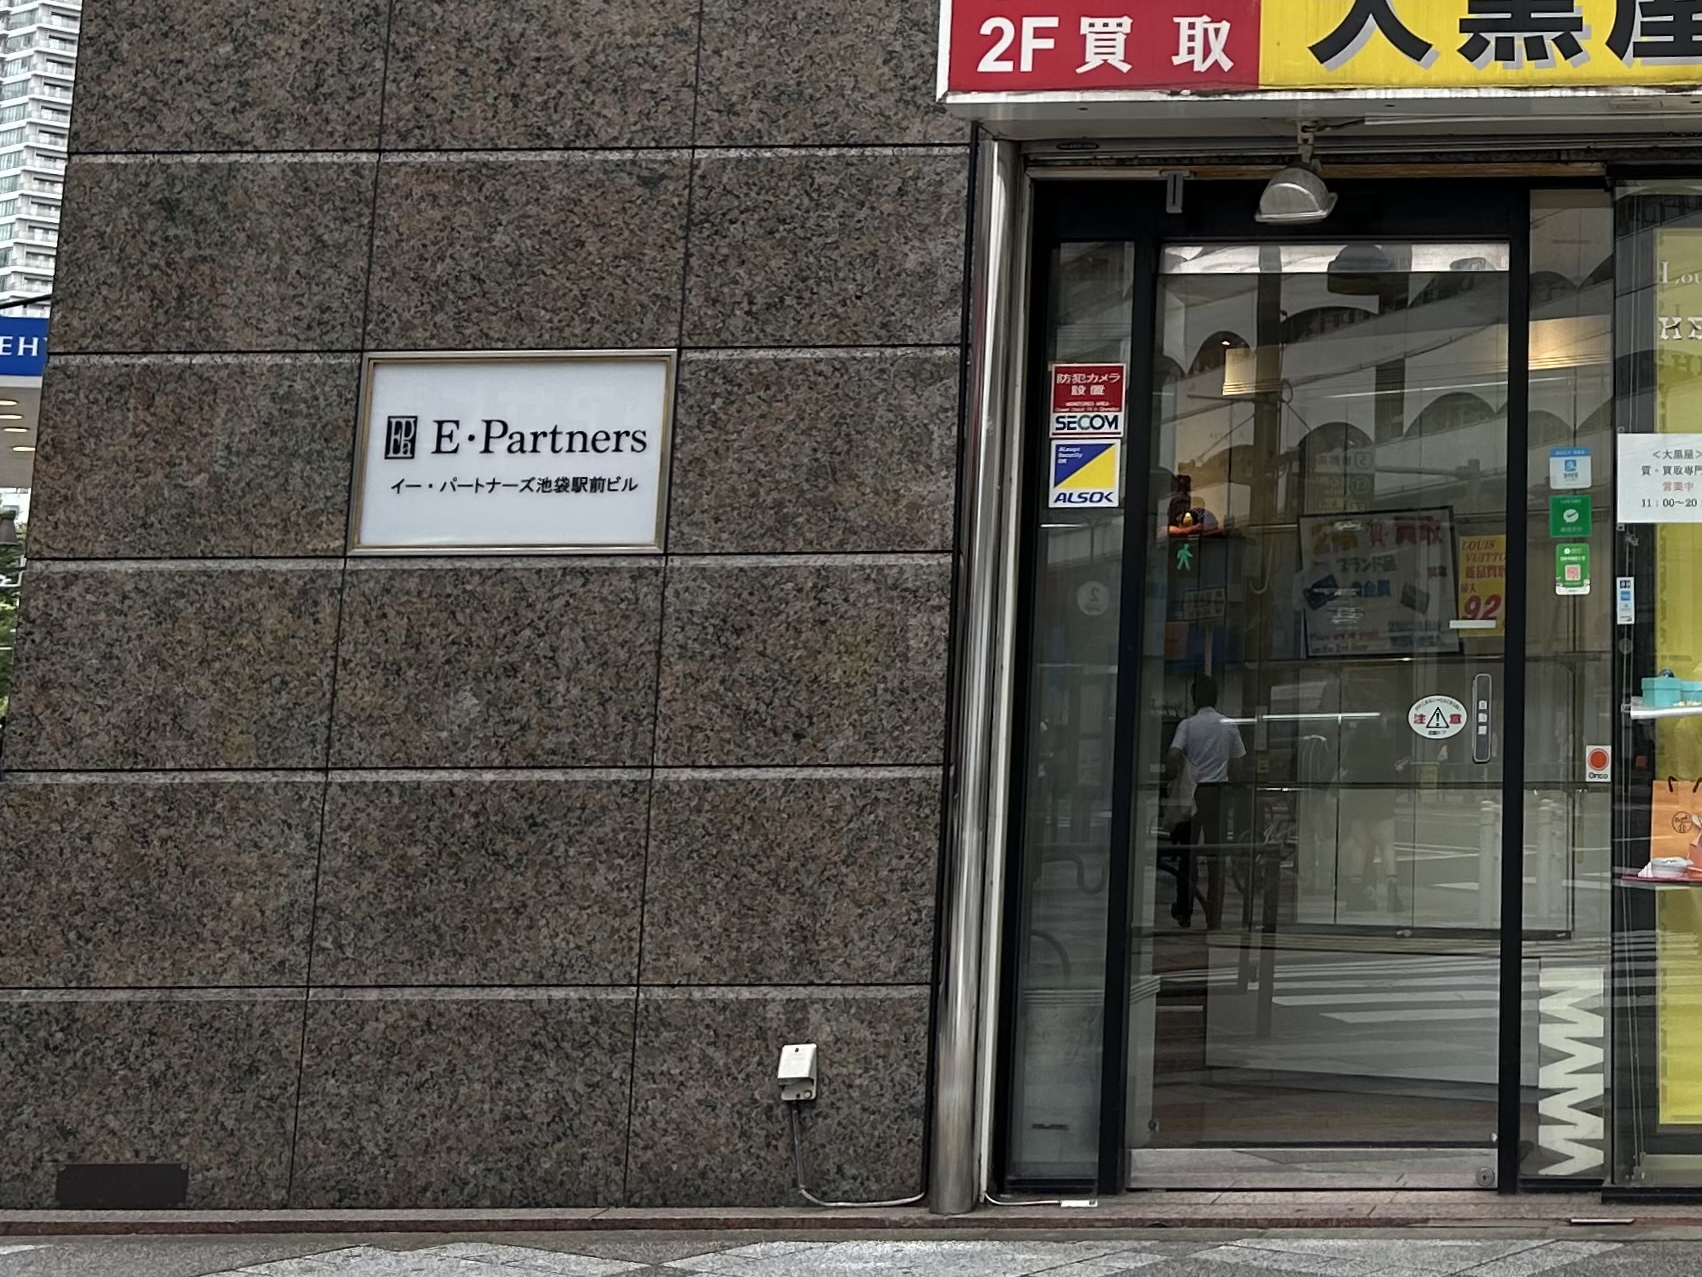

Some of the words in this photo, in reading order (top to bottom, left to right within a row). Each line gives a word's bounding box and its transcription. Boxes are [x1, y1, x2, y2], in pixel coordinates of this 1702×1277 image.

[977, 16, 1060, 73] 2F
[0, 335, 48, 357] EH
[1055, 414, 1119, 430] SECOM
[390, 476, 639, 495] イー・パートナーズ池袋駅前ビル
[1053, 491, 1114, 504] ALSOK
[1461, 539, 1496, 551] LOUIS
[1463, 593, 1503, 620] 92
